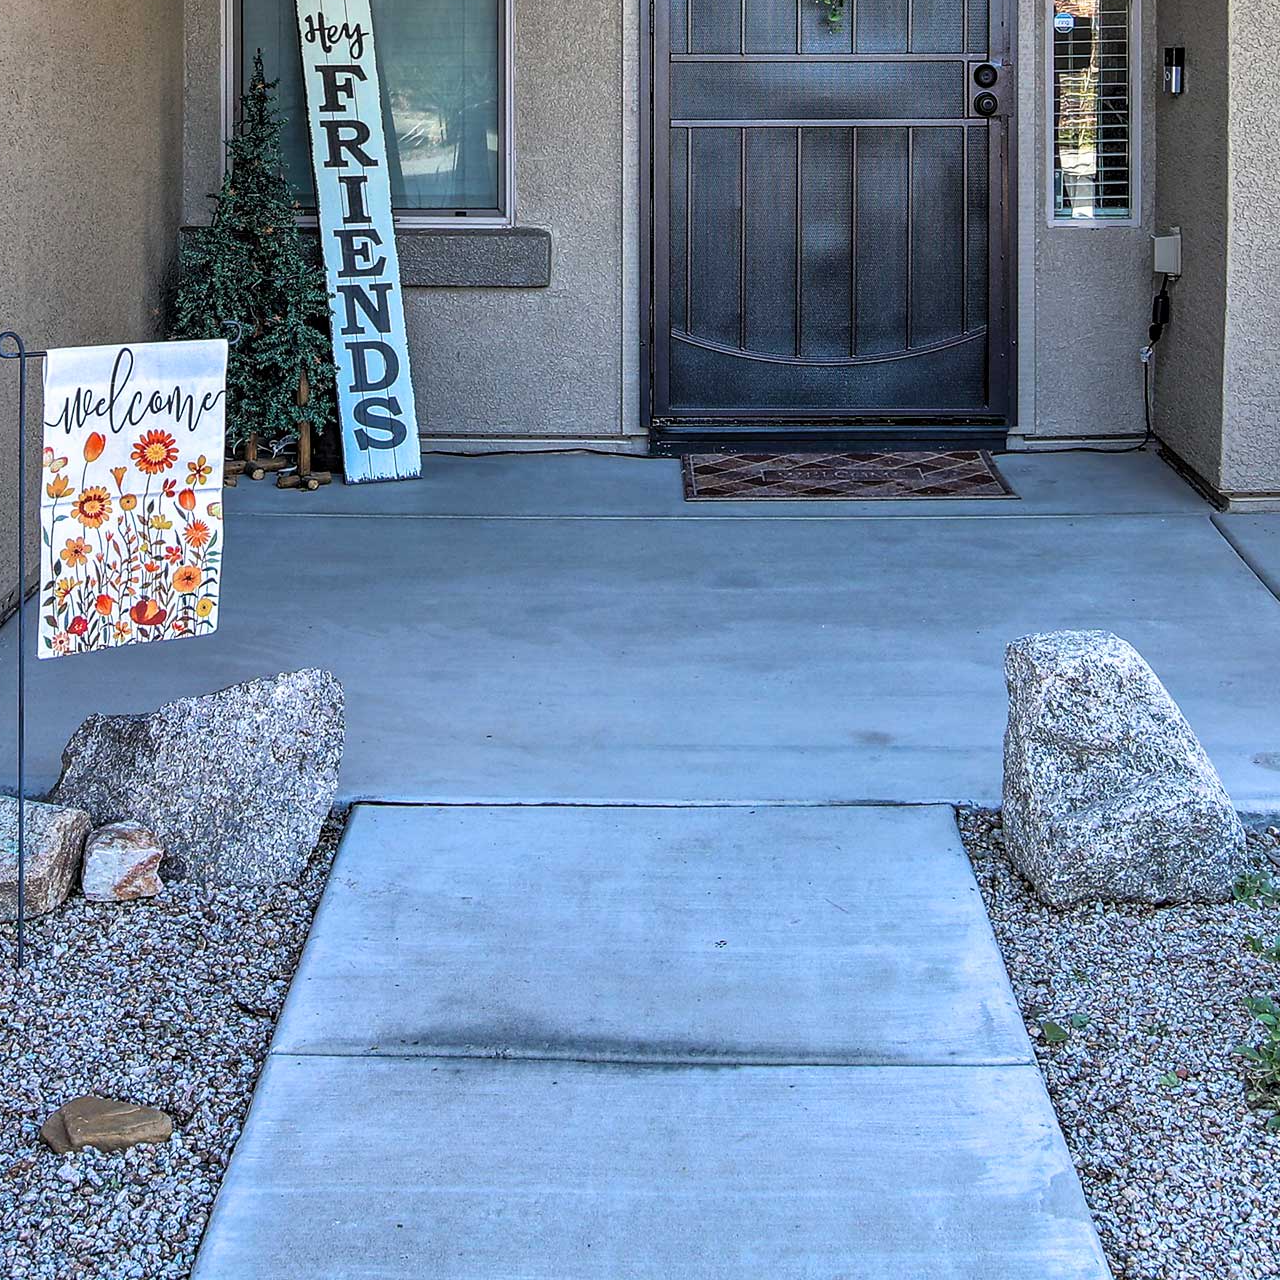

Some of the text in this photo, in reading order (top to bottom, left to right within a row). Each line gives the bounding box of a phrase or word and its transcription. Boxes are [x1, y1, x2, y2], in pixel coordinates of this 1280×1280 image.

[304, 11, 370, 60] Hey
[314, 65, 408, 452] FRIENDS
[44, 347, 227, 435] welcome
